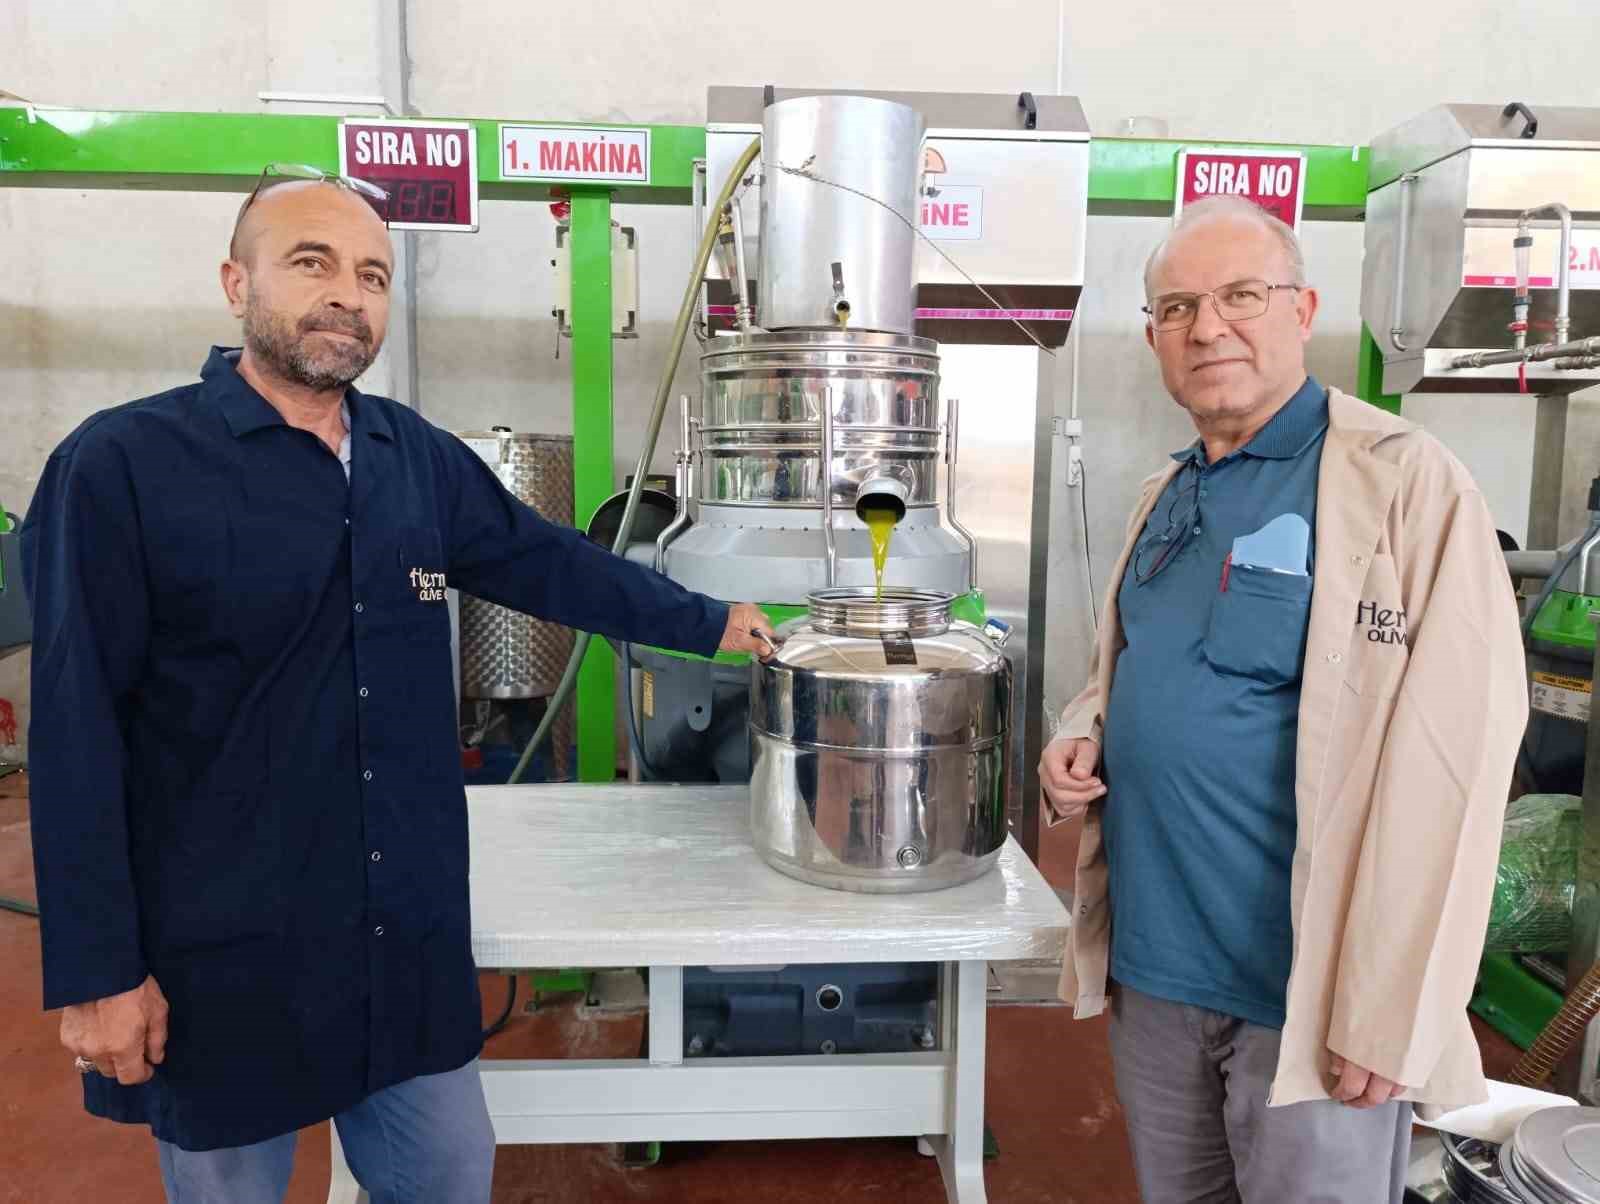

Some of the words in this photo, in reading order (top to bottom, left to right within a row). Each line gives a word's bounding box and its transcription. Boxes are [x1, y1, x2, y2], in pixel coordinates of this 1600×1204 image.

[355, 131, 418, 166] SIRA
[425, 133, 461, 167] NO
[506, 139, 529, 170] 1.
[539, 135, 643, 174] MAKİNA
[1193, 161, 1250, 195] SIRA
[1258, 164, 1293, 197] NO
